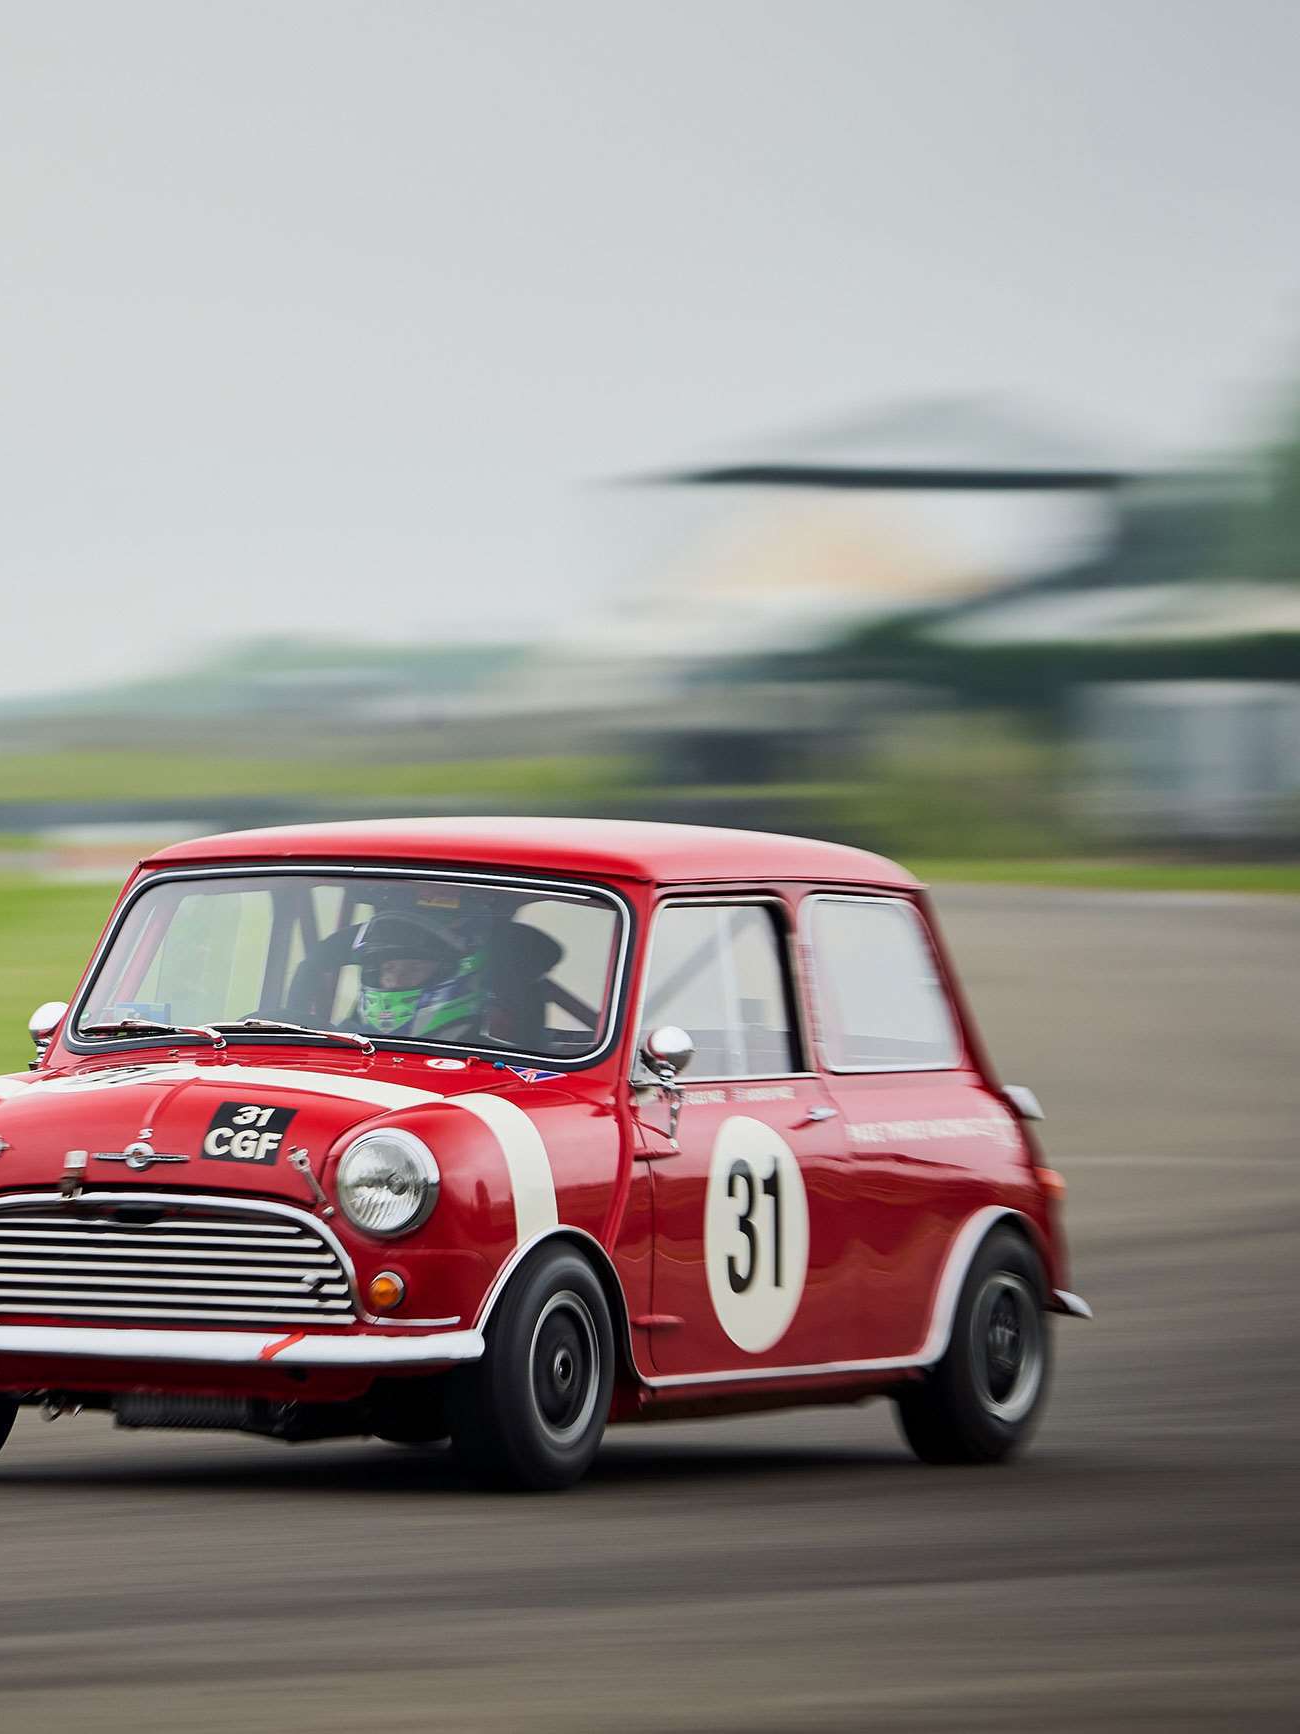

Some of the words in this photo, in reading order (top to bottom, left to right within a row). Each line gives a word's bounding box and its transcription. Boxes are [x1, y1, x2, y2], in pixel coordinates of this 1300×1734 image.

[232, 1105, 276, 1127] 31
[203, 1127, 283, 1160] CGF
[726, 1156, 782, 1294] 31
